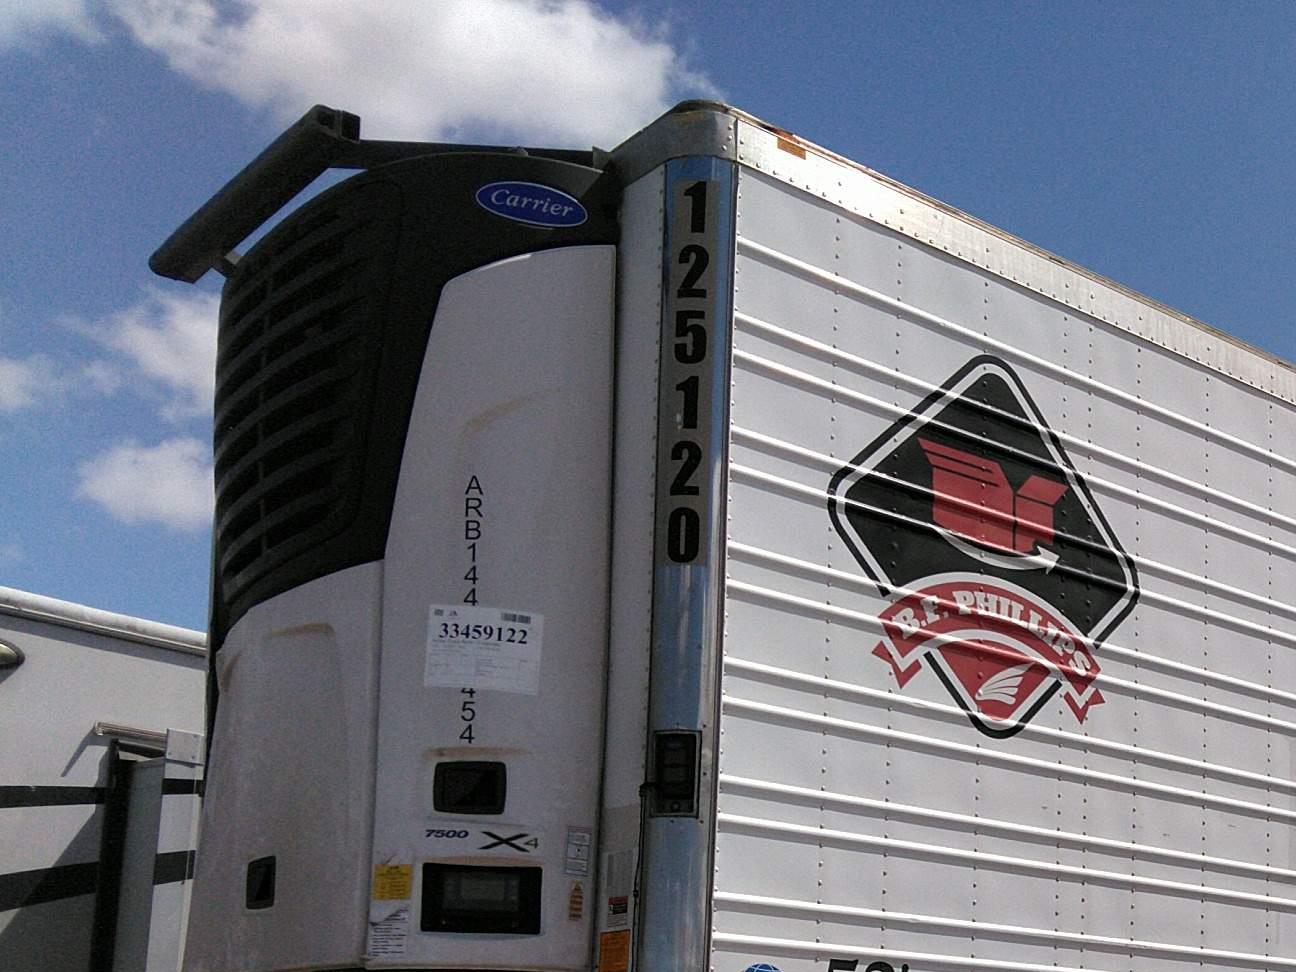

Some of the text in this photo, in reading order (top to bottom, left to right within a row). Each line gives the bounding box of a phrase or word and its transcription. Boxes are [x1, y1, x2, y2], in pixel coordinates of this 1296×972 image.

[490, 188, 574, 217] Carrier
[667, 180, 710, 564] 125120
[438, 622, 528, 645] 33459122
[891, 590, 1091, 677] B.F. PHILLIPS
[424, 828, 539, 853] 7500 X4
